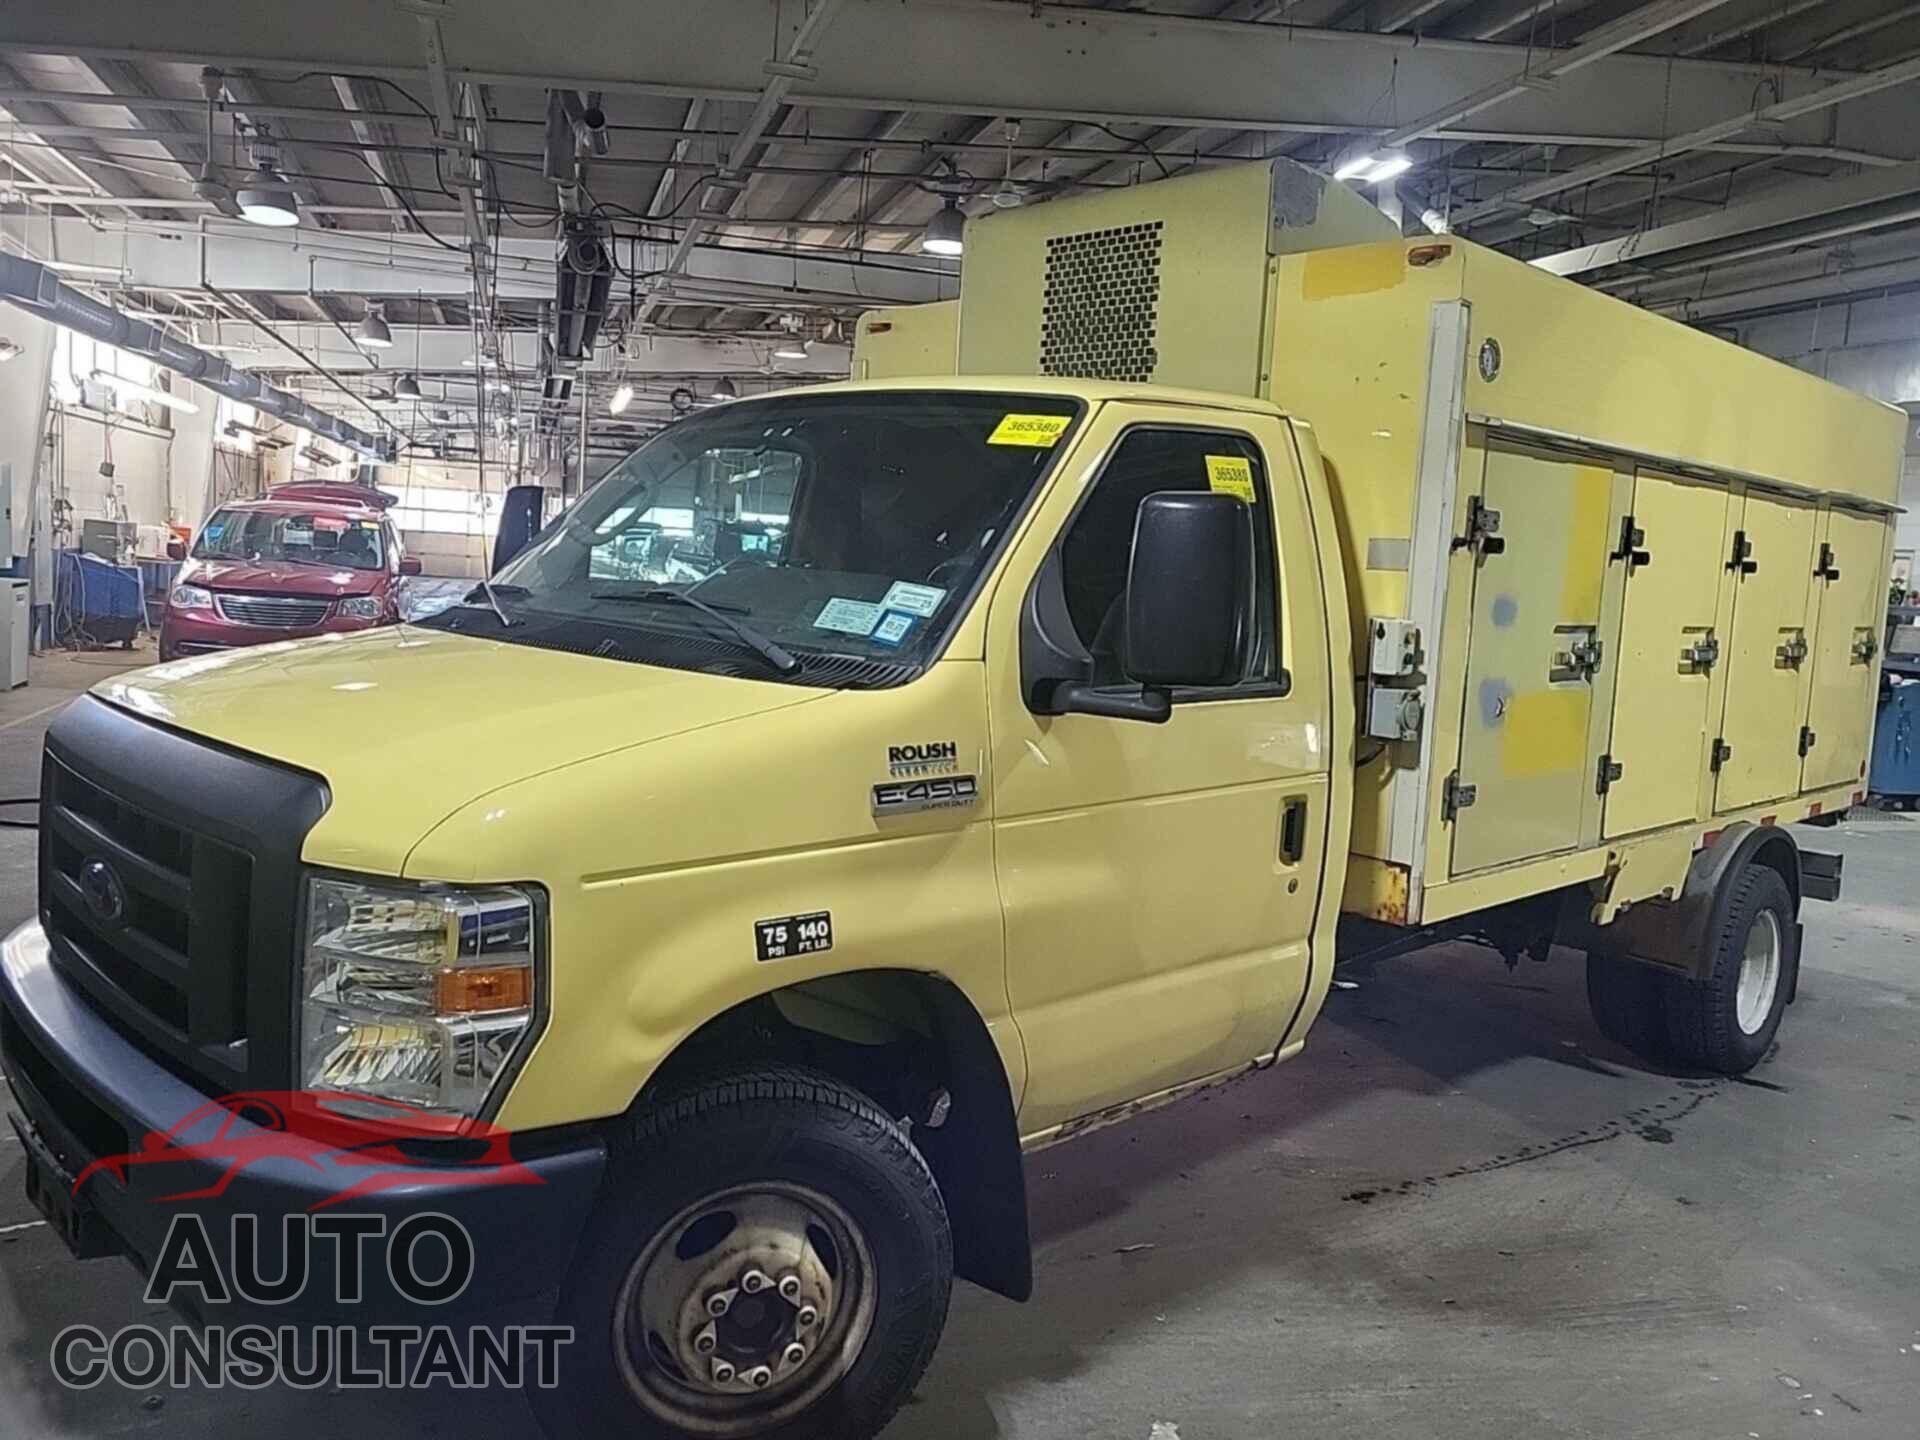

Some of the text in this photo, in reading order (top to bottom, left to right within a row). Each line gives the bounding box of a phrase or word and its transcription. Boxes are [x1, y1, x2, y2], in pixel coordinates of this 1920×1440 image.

[1008, 421, 1061, 433] 365380
[888, 741, 956, 762] ROUSH
[876, 779, 977, 806] E-450
[762, 925, 789, 946] 75
[797, 920, 829, 940] 140
[767, 945, 786, 958] PSI
